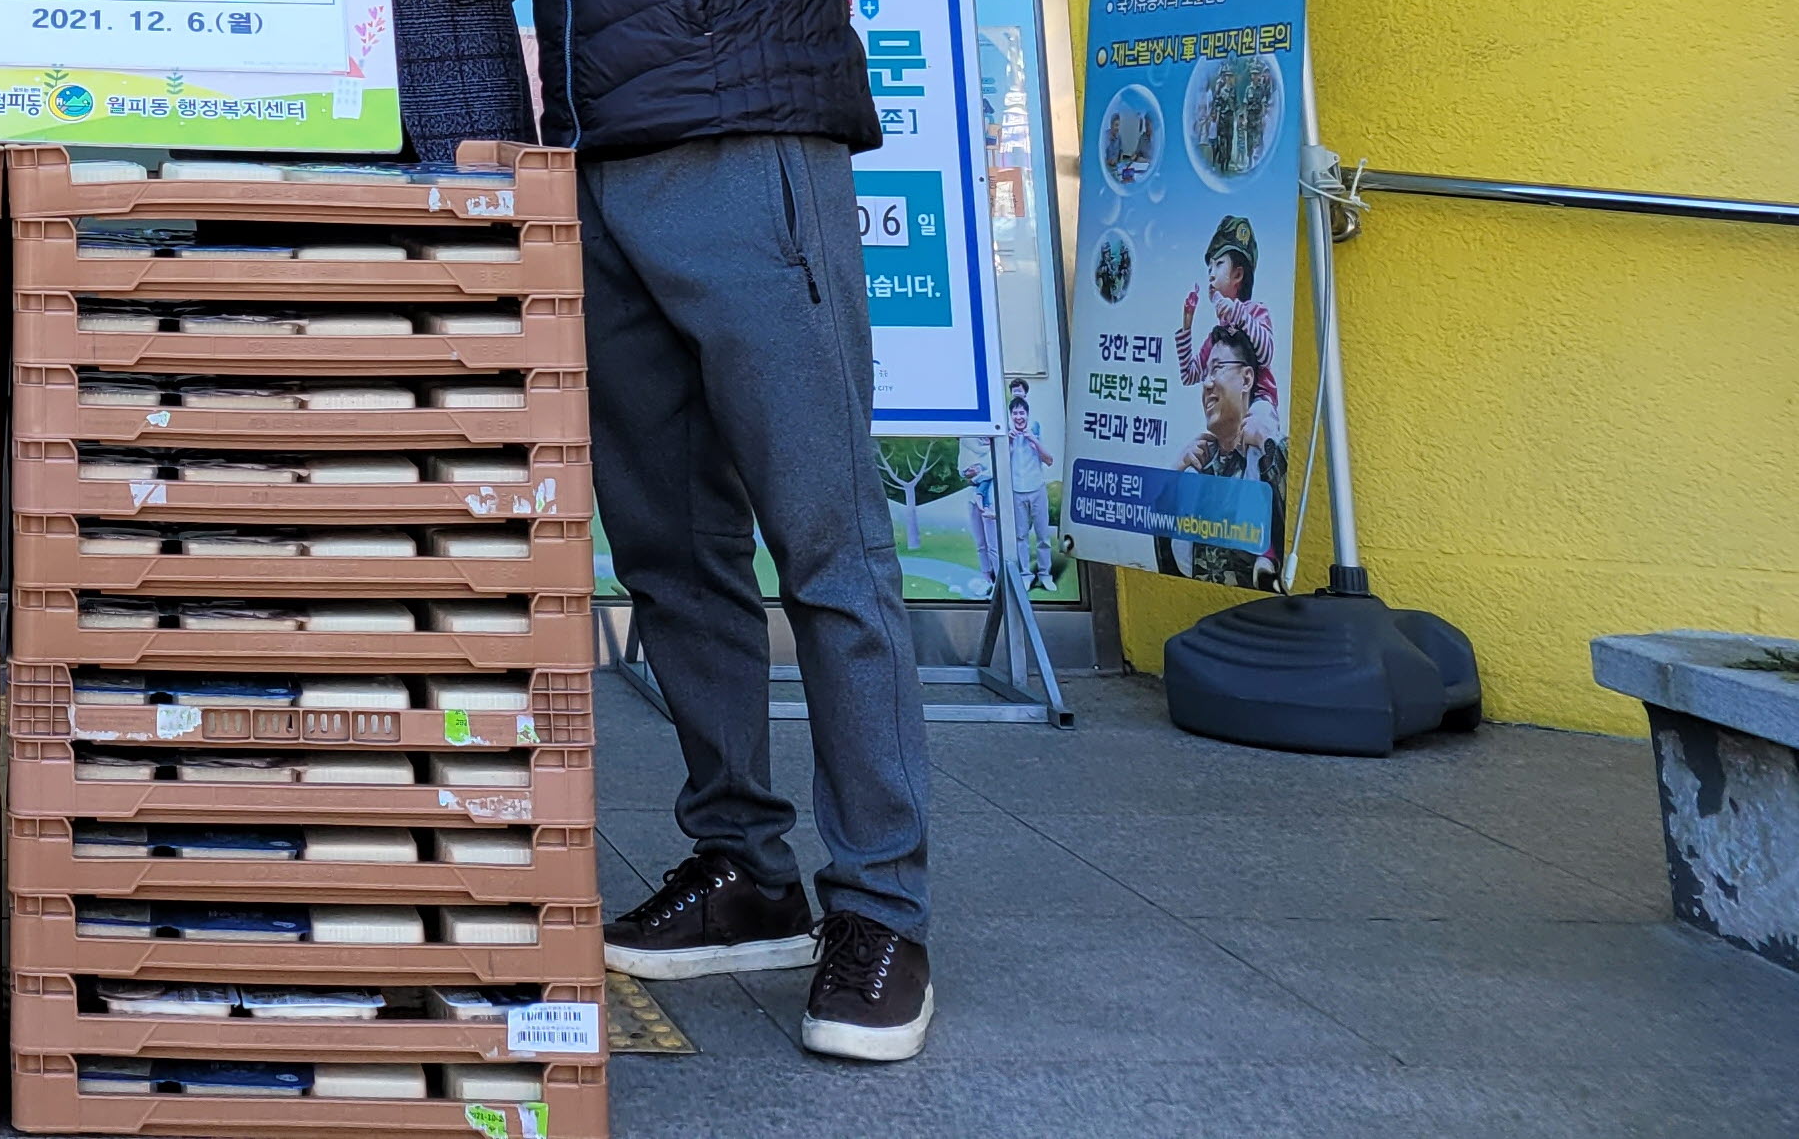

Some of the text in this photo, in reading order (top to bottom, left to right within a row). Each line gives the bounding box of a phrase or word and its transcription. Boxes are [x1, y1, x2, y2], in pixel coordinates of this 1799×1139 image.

[31, 8, 264, 36] 2021. 12. 6.(월)
[1112, 36, 1178, 68] 재난발생시
[1201, 28, 1257, 58] 대민지원
[1259, 23, 1291, 52] 문의
[106, 96, 306, 120] 월피동 행정복지센터
[918, 213, 937, 237] 일
[1099, 334, 1163, 364] 강한 군대
[1089, 372, 1168, 405] 따뜻한 육군
[1084, 412, 1168, 447] 국민과 함께!
[1077, 469, 1143, 499] 기타사항 문의
